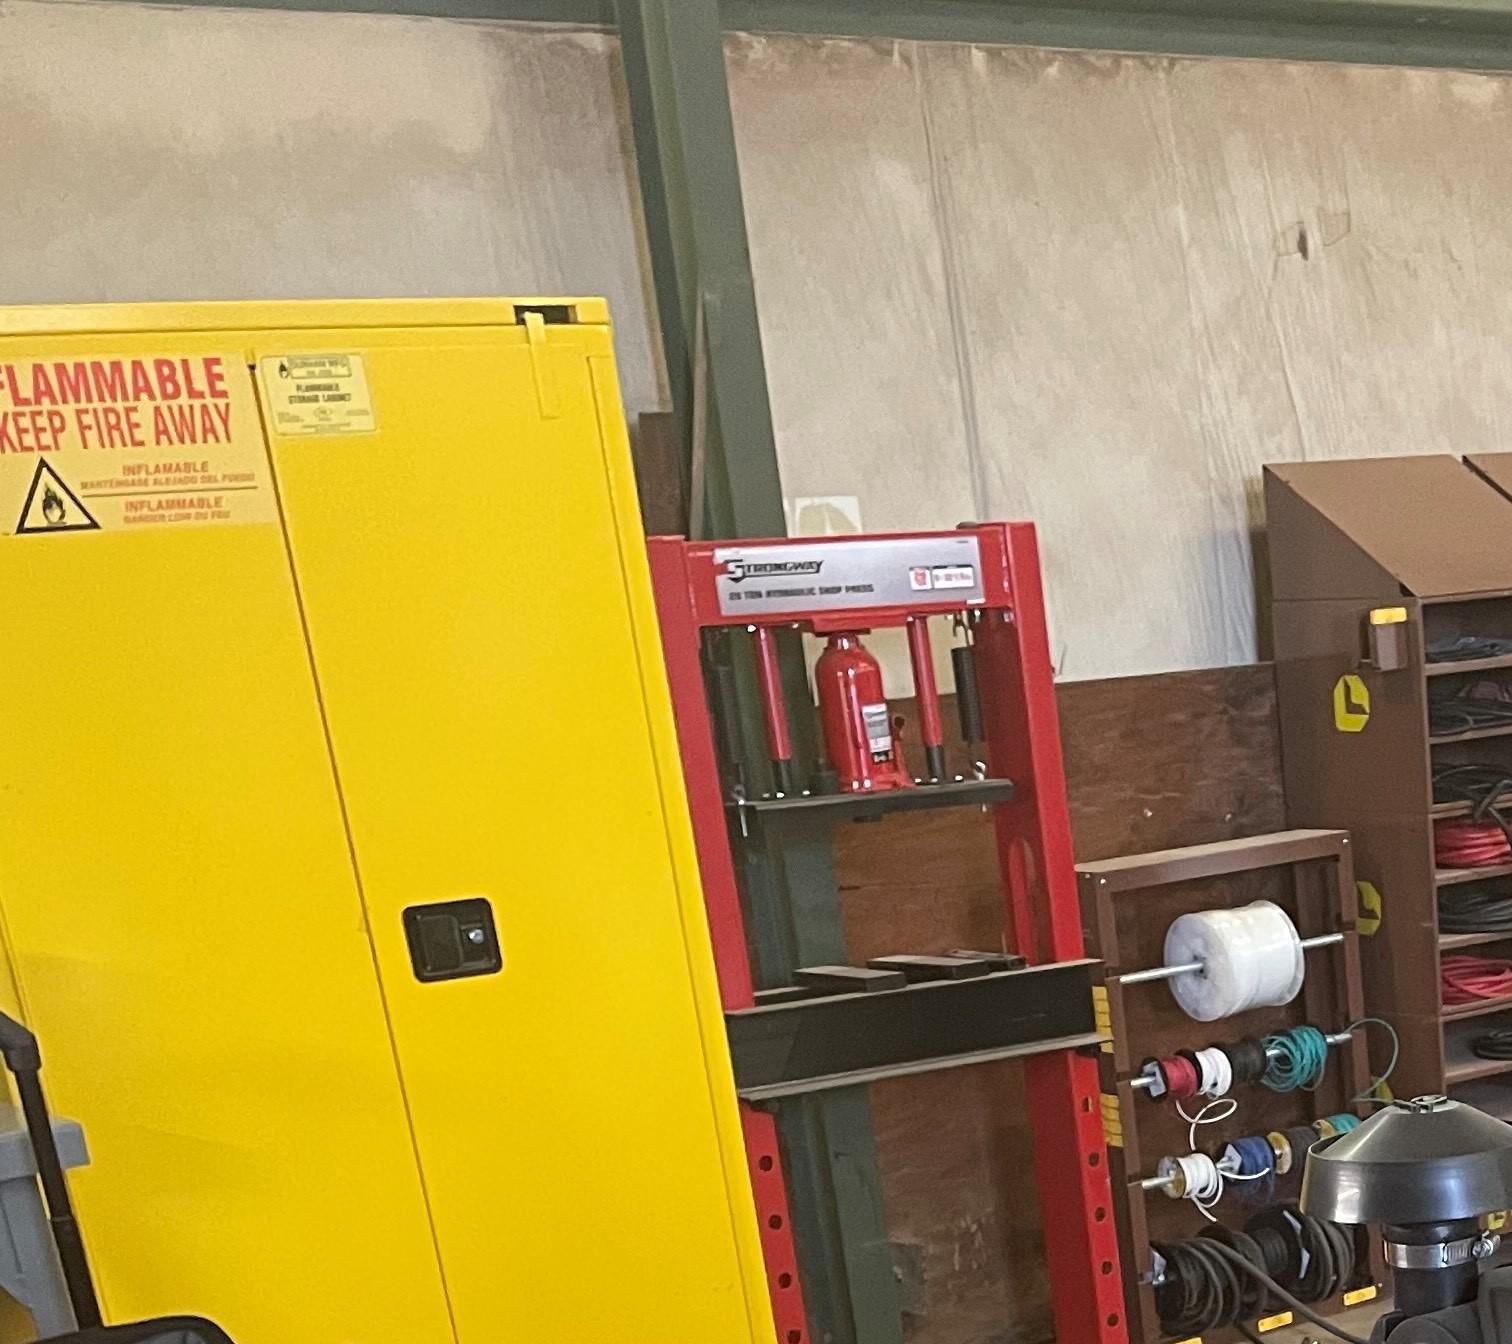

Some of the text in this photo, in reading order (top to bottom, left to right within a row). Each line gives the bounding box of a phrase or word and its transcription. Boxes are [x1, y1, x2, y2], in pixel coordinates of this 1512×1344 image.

[0, 357, 229, 407] LAMMABLE
[75, 406, 146, 450] FIRE
[153, 402, 232, 446] AWAY
[122, 461, 209, 476] INFLAMABLE
[125, 496, 223, 512] INFLAMMABLE
[725, 559, 823, 583] STRONGWAY
